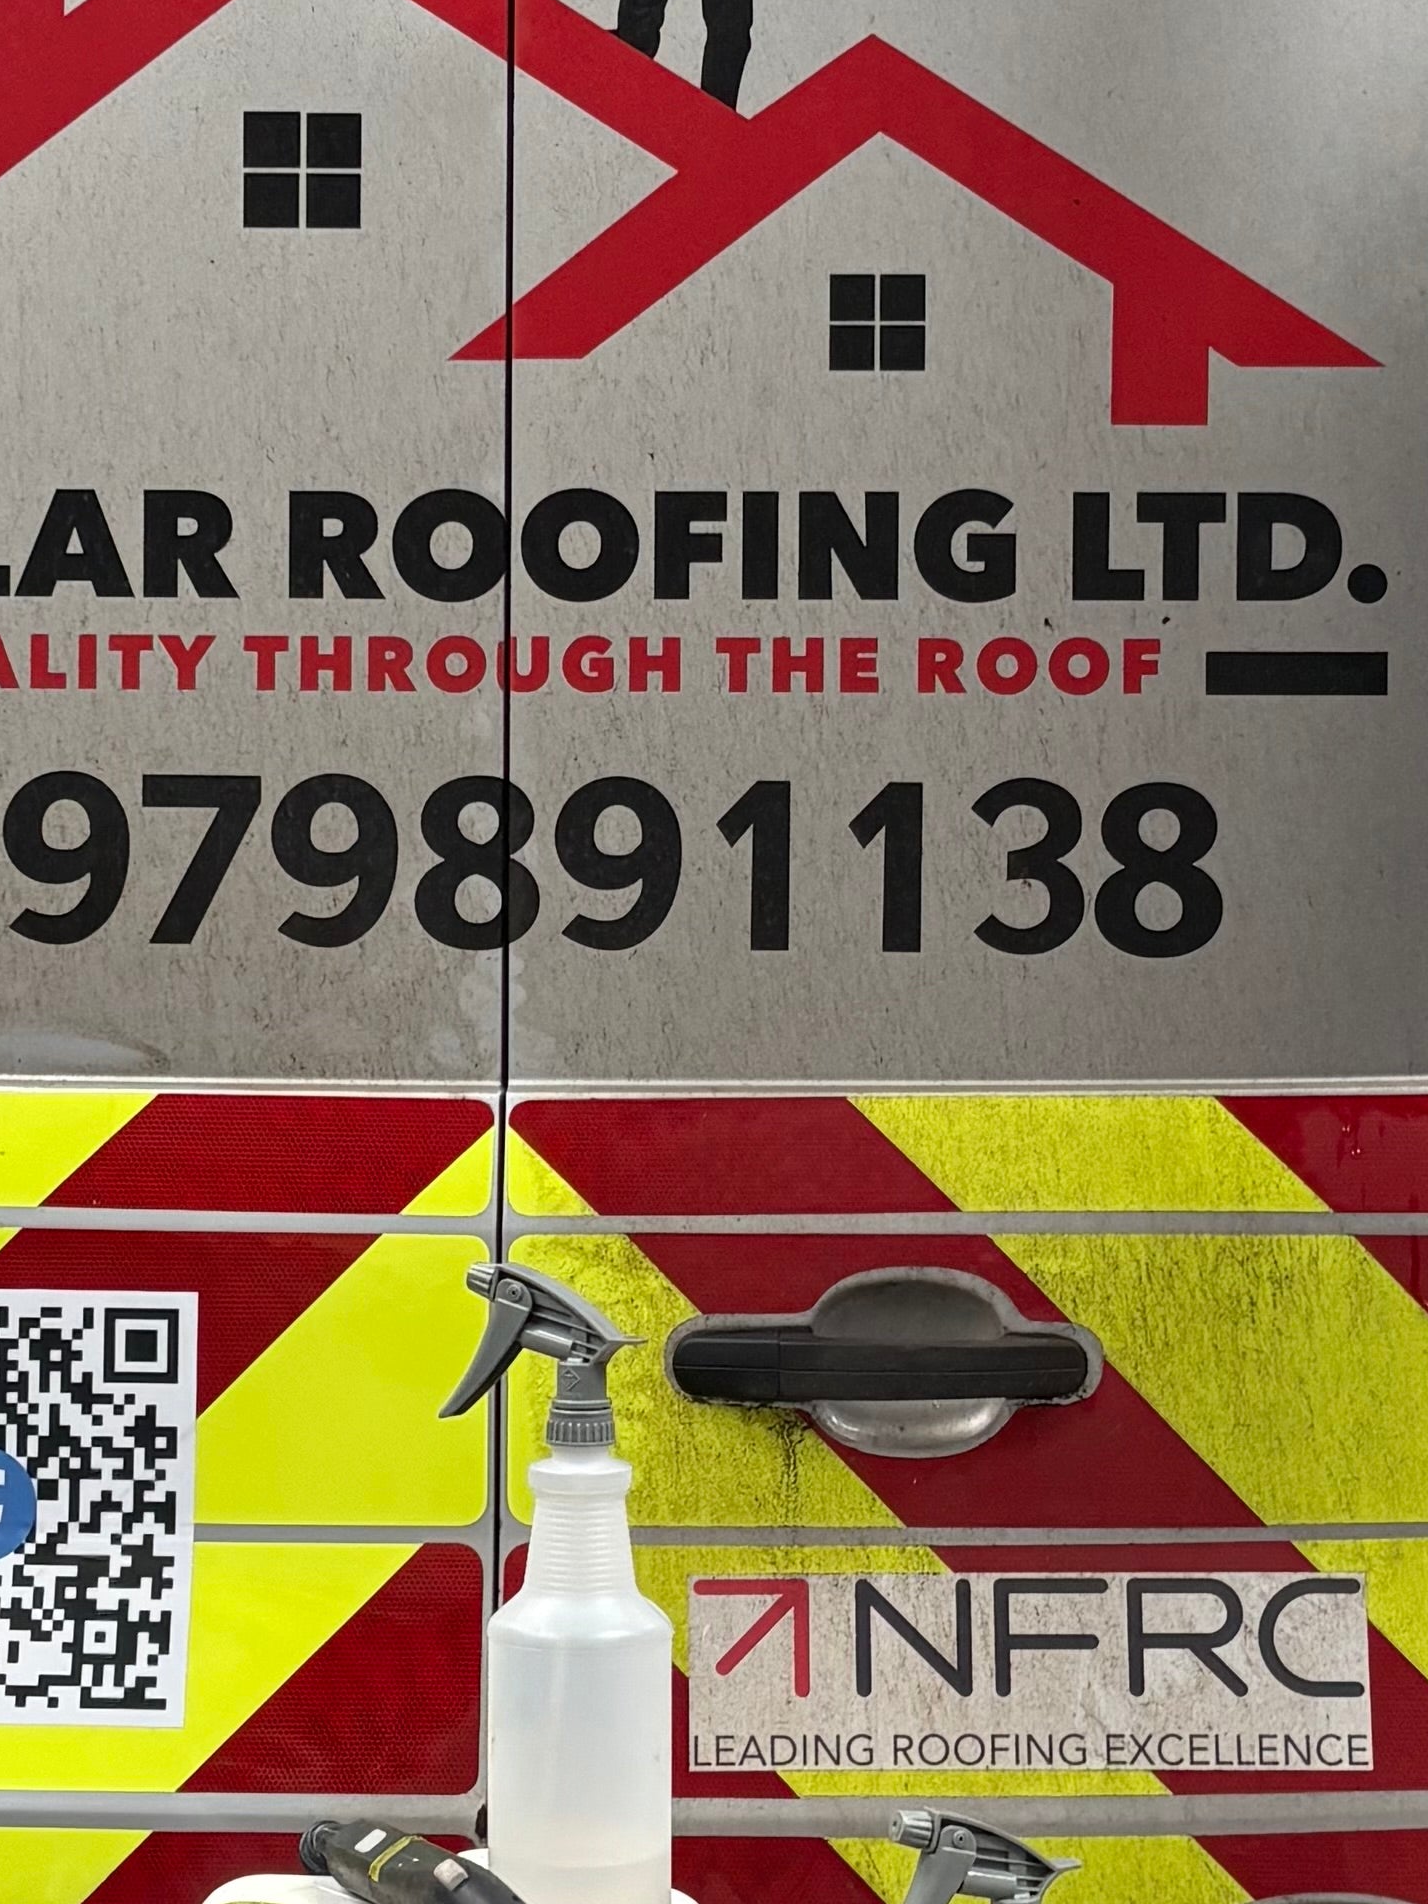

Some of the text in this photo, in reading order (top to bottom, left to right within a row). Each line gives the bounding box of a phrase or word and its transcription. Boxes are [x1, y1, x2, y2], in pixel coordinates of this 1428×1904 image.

[288, 484, 1017, 604] ROOFING
[1071, 491, 1388, 604] LTD.
[243, 634, 681, 694] THROUGH
[716, 637, 879, 694] THE
[917, 637, 1162, 696] ROOF
[855, 1578, 1365, 1698] NFRC
[693, 1733, 1369, 1767] LEADING ROOFING EXCELLENCE
